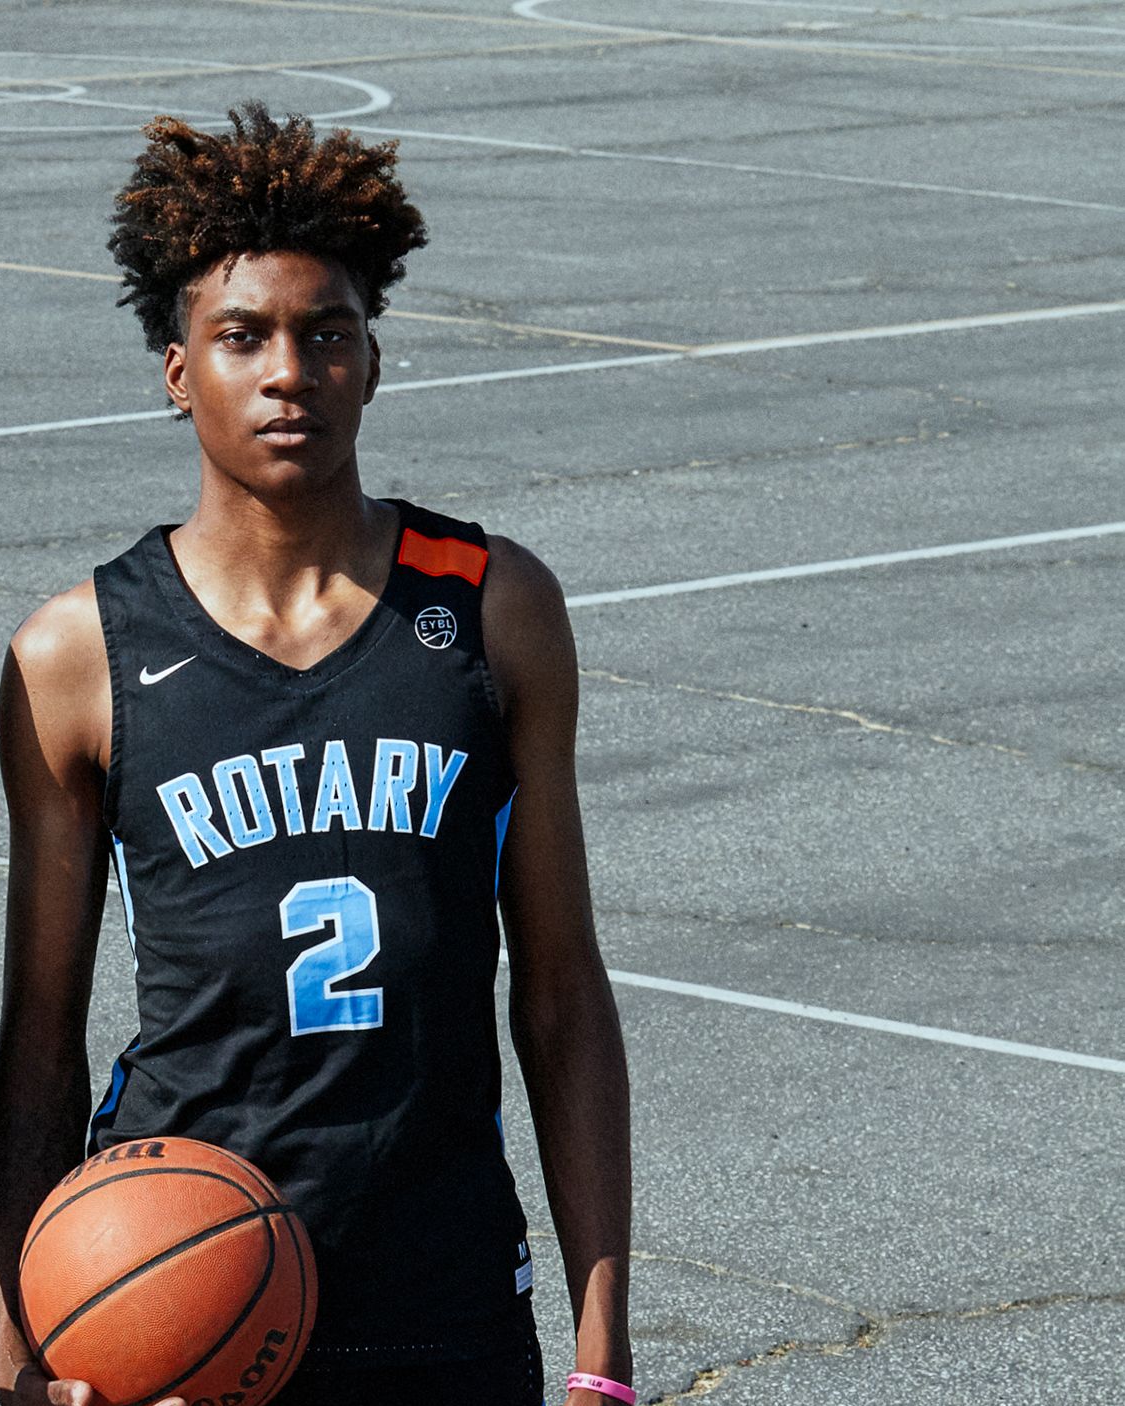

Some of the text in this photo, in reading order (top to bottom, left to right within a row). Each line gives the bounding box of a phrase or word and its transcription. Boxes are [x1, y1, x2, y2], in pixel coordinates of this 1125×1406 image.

[420, 619, 453, 630] EYBL
[156, 738, 469, 869] ROTARY
[279, 875, 383, 1037] 2
